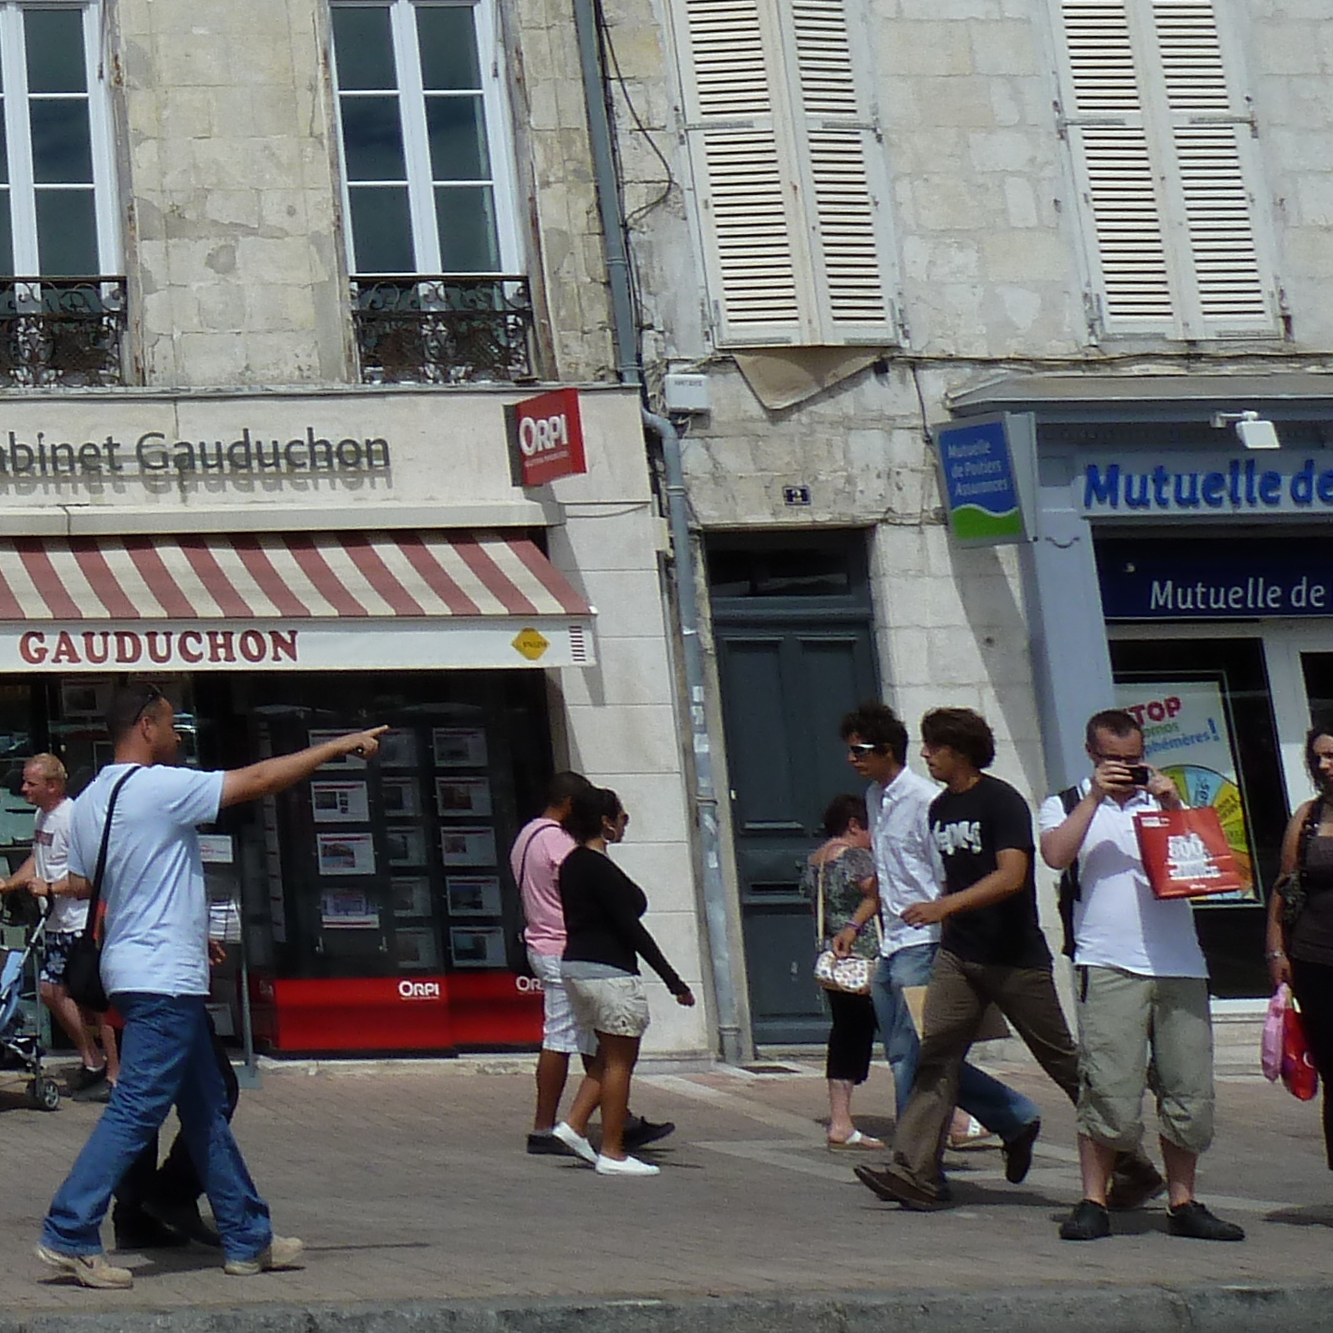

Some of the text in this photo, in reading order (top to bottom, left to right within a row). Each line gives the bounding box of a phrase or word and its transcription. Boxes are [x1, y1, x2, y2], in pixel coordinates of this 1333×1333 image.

[519, 414, 568, 456] ORPI
[136, 427, 390, 470] Gauduchon
[948, 439, 991, 458] Mutuelle
[951, 461, 1002, 478] de Poitiers
[955, 479, 1007, 496] Assurances
[1084, 459, 1282, 509] Mutuelle
[1151, 576, 1325, 609] Mutuelle de
[19, 630, 298, 664] GAUDUCHON
[1122, 696, 1181, 725] TOP
[1143, 722, 1179, 737] omos
[398, 981, 440, 996] ORPI
[515, 976, 544, 991] OR
